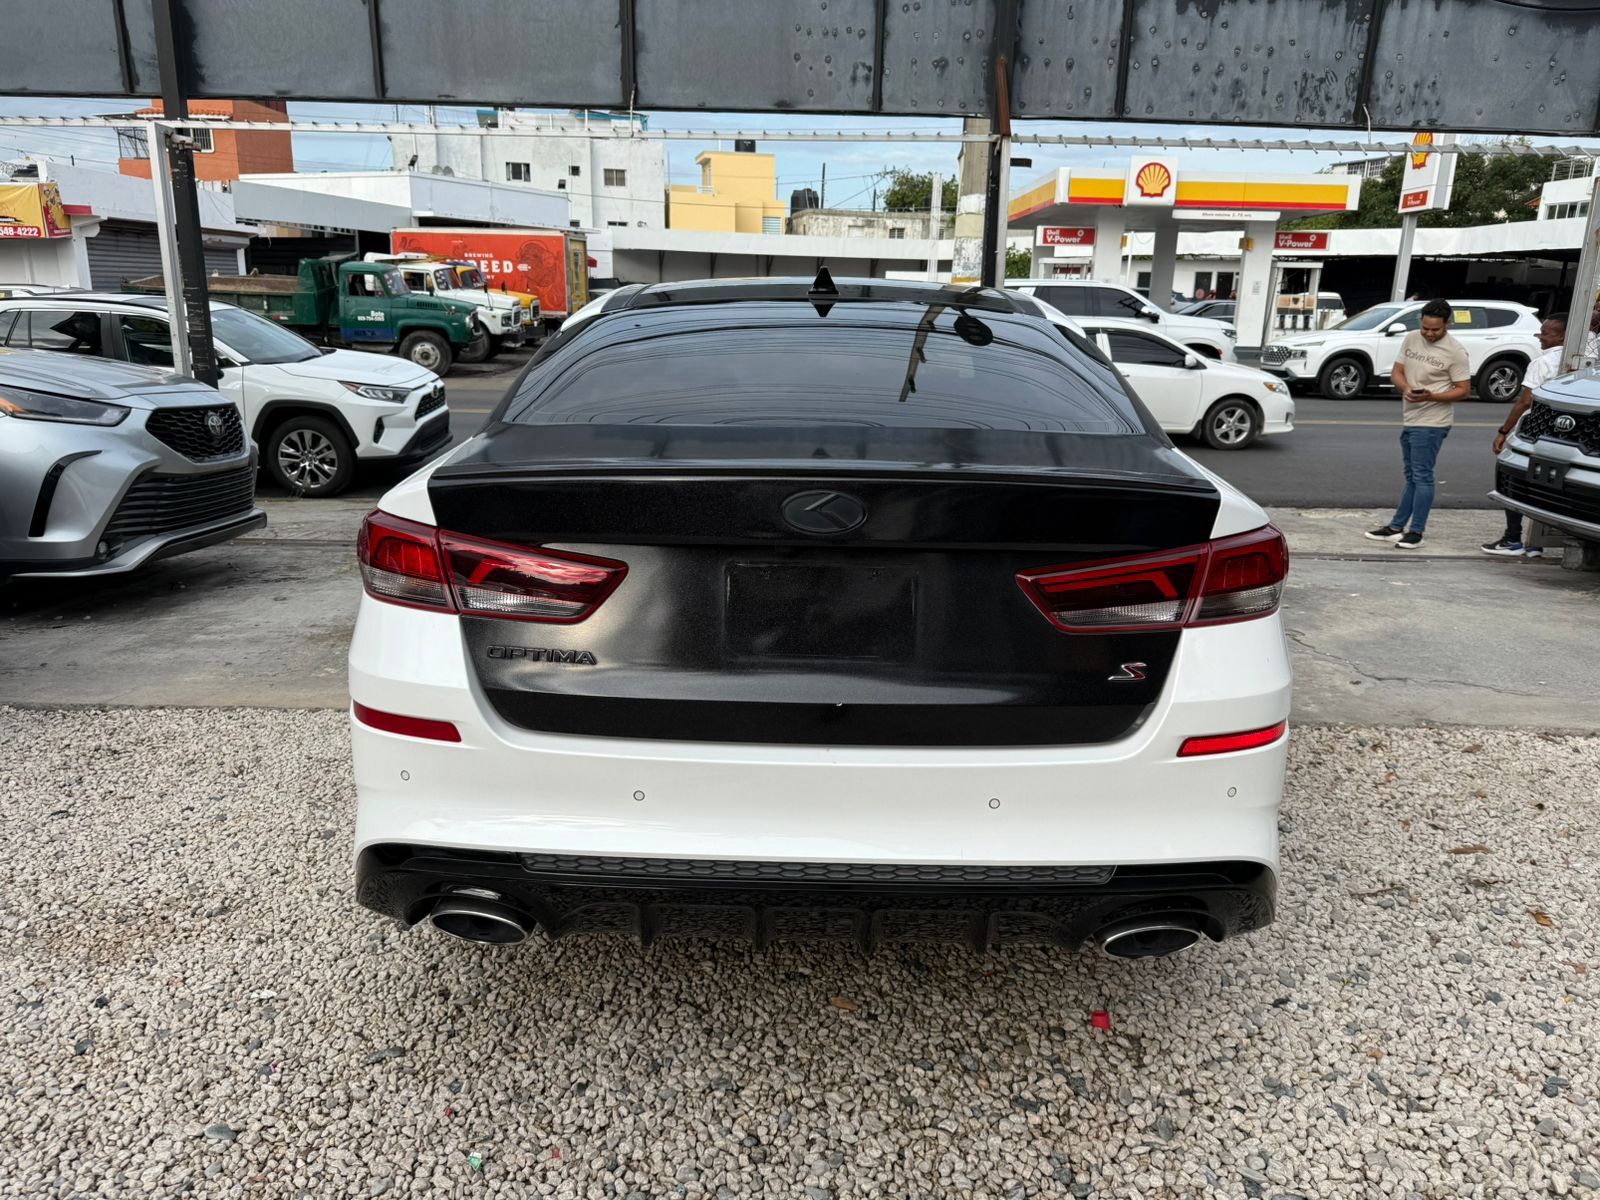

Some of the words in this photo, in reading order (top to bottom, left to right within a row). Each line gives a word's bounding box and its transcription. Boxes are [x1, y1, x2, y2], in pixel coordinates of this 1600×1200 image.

[1046, 235, 1081, 243] V-Power
[1278, 239, 1314, 248] V-Power
[1404, 348, 1425, 361] Calvin
[1425, 355, 1445, 368] Klein
[1556, 417, 1571, 429] KIA
[486, 644, 598, 666] OPTIMA
[1107, 662, 1147, 681] S
